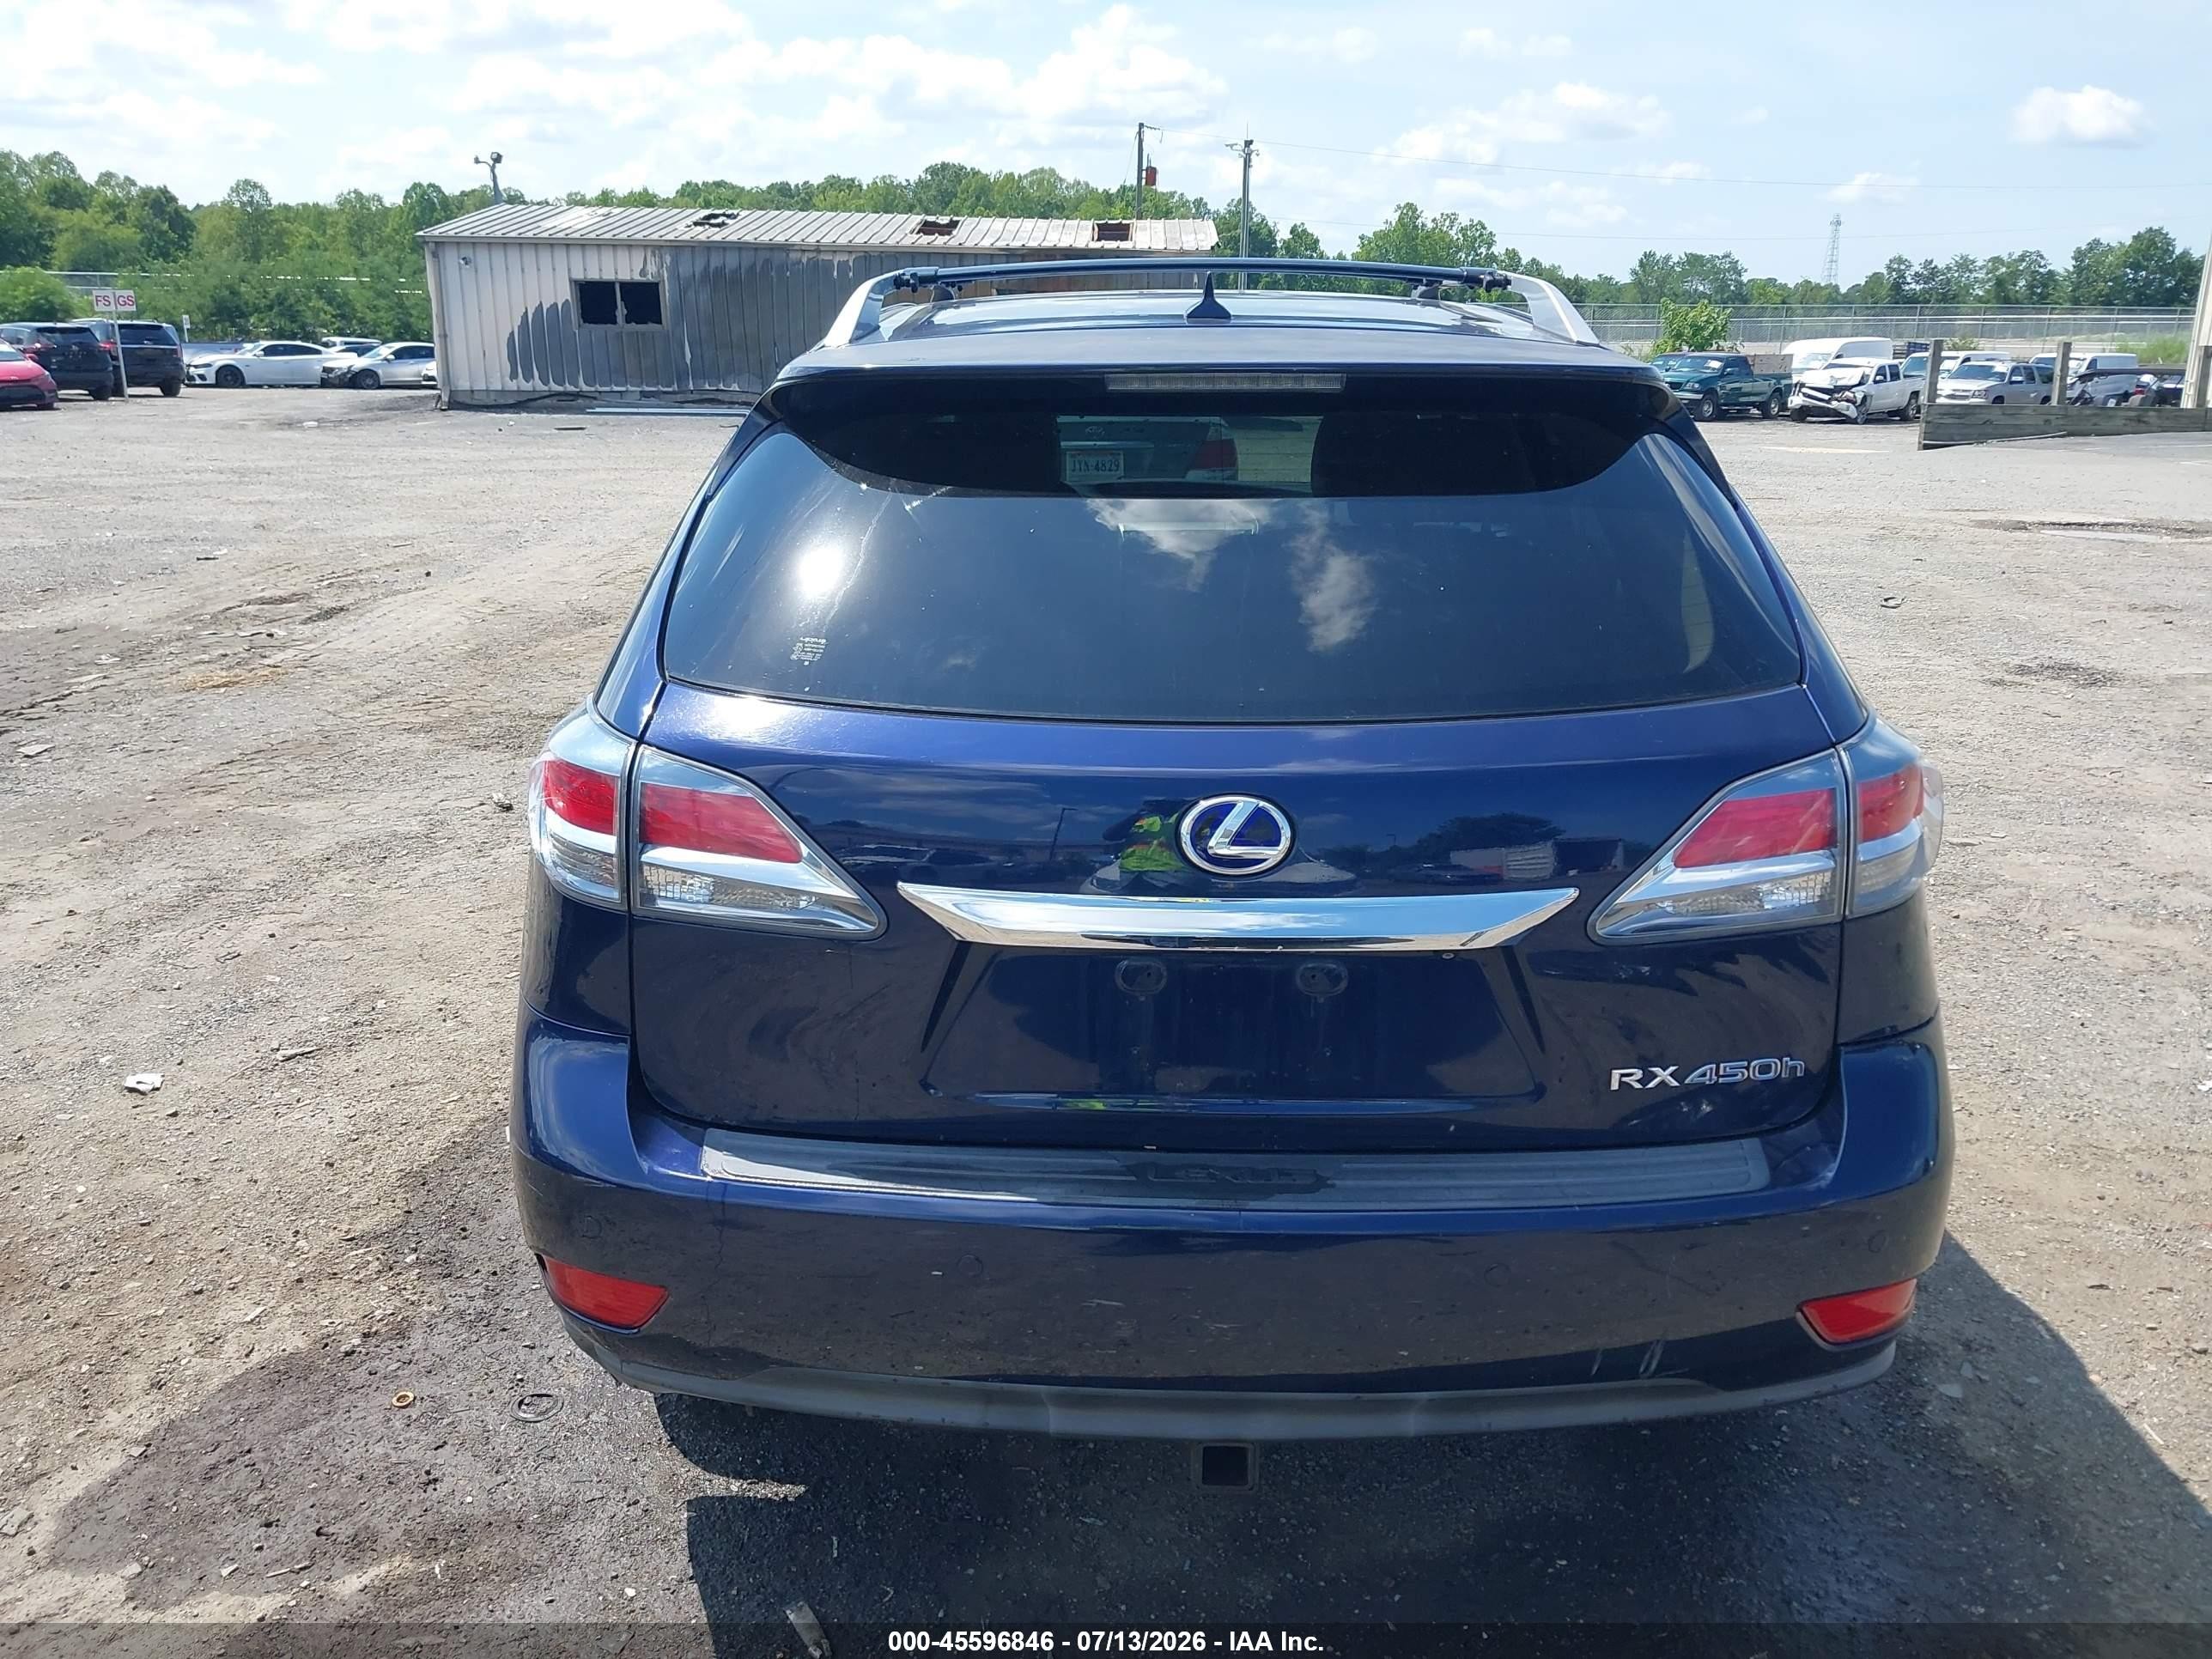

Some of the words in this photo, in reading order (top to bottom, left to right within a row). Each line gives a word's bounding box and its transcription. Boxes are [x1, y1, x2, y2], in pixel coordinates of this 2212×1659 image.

[94, 295, 112, 307] FS
[117, 295, 135, 307] GS
[1610, 1065, 1680, 1091] RX
[1683, 1057, 1805, 1085] 450h
